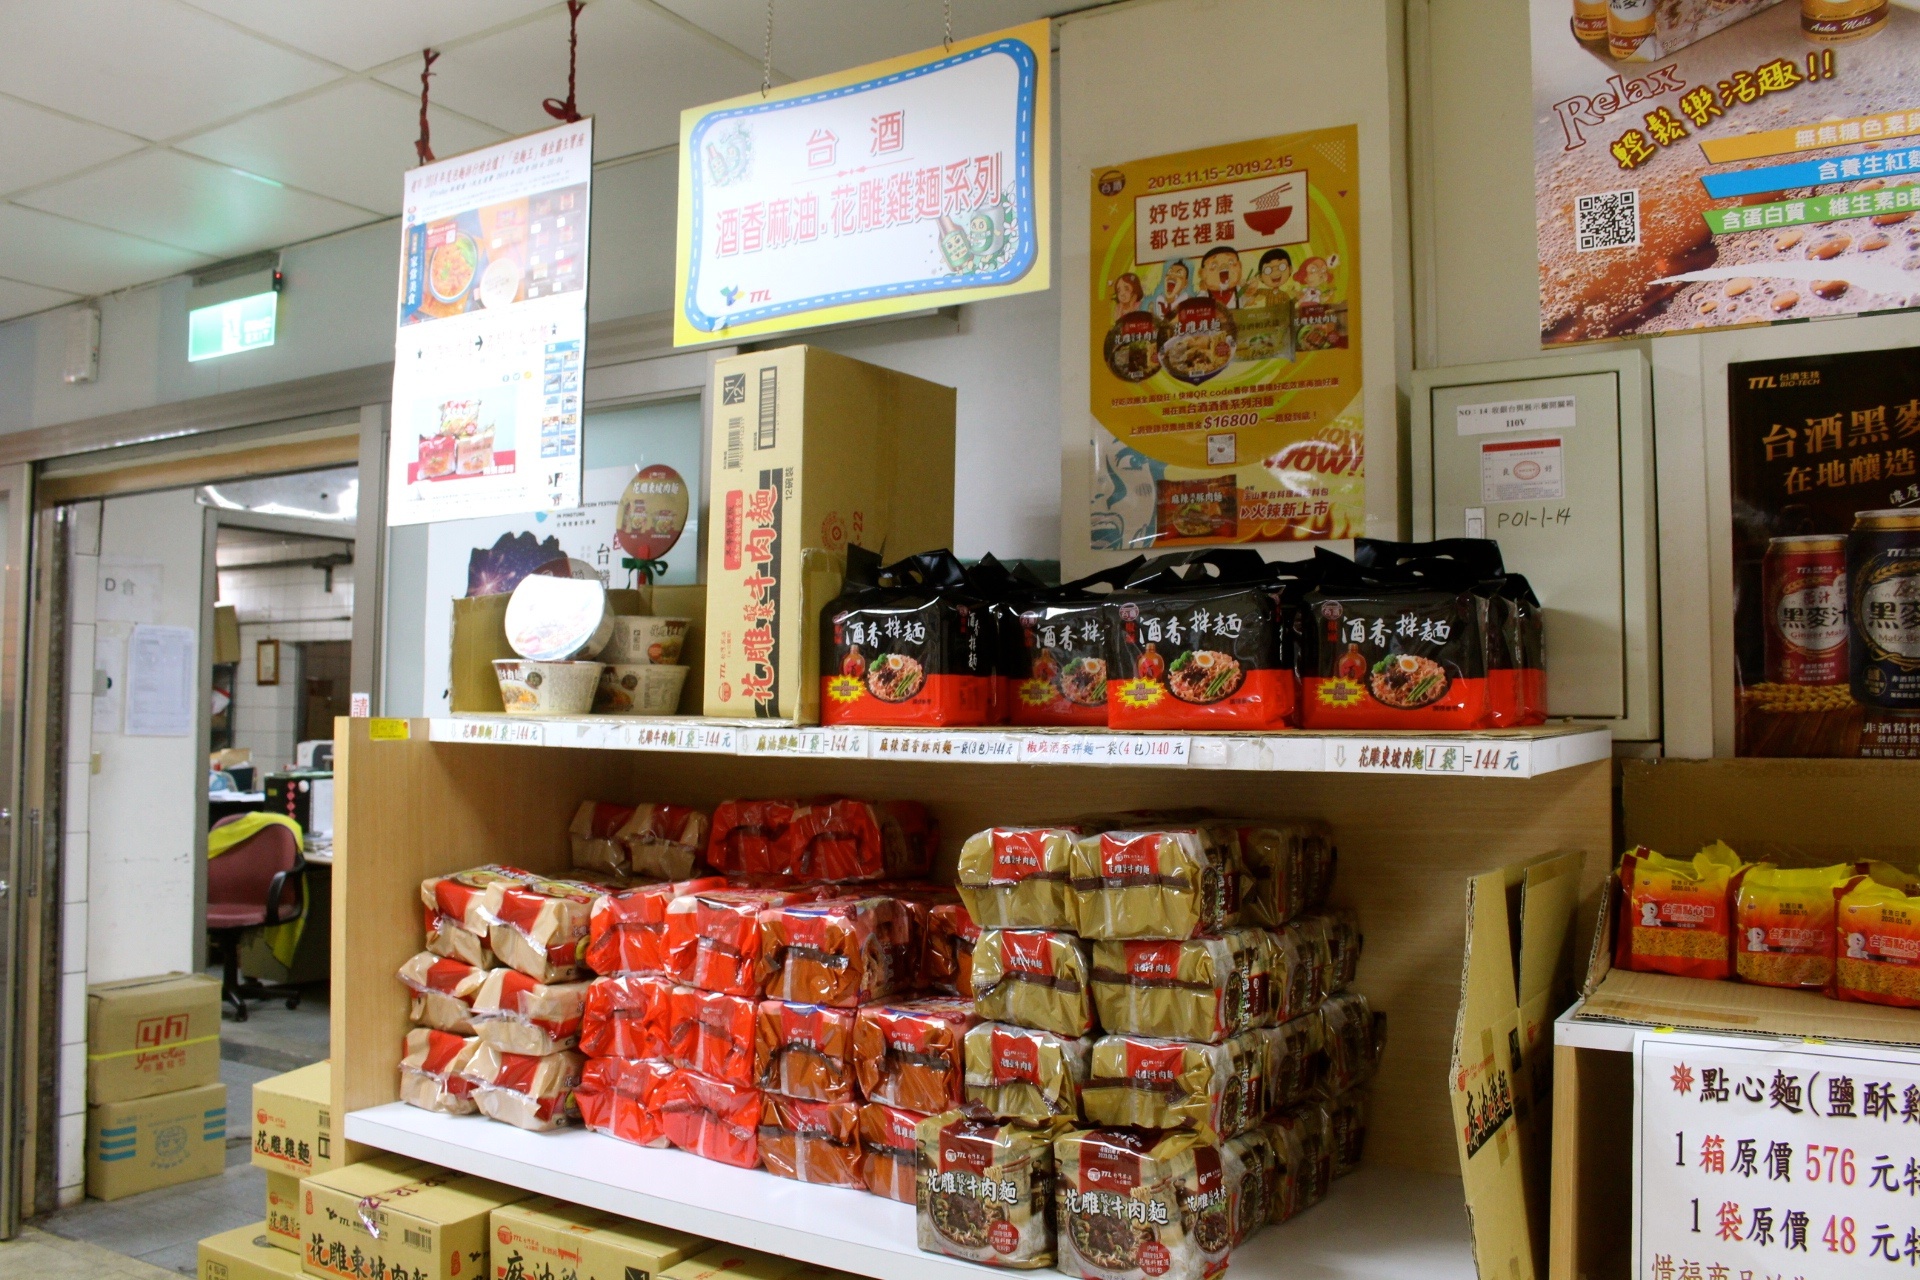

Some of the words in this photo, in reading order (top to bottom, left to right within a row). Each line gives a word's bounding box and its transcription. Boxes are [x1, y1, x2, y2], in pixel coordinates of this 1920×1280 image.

[1841, 17, 1872, 31] Malz
[1553, 64, 1686, 151] Relax
[1148, 155, 1294, 190] 2018.11.15-2019.2.15
[1150, 195, 1234, 225] 好吃好康
[1150, 220, 1236, 251] 都在裡麵
[749, 288, 772, 303] TTL
[1748, 376, 1778, 390] TTL
[1203, 412, 1259, 431] $16800
[1506, 418, 1527, 428] 110V
[1784, 447, 1916, 495] 在地釀造
[1251, 500, 1329, 520] 火辣新上市
[104, 577, 116, 592] D
[1139, 608, 1242, 647] 酒香拌麵
[1342, 612, 1452, 647] 酒香拌麵
[1782, 604, 1850, 629] 黑麥汁
[845, 617, 926, 650] 酒香拌麵
[1037, 621, 1105, 652] 酒香拌
[256, 1130, 312, 1166] 花雕雞麵
[1675, 1131, 1686, 1166] 1
[1805, 1144, 1856, 1186] 576
[1101, 1170, 1112, 1178] TTL
[339, 1216, 351, 1228] TTL
[1690, 1198, 1701, 1233] 1
[1822, 1215, 1857, 1254] 48
